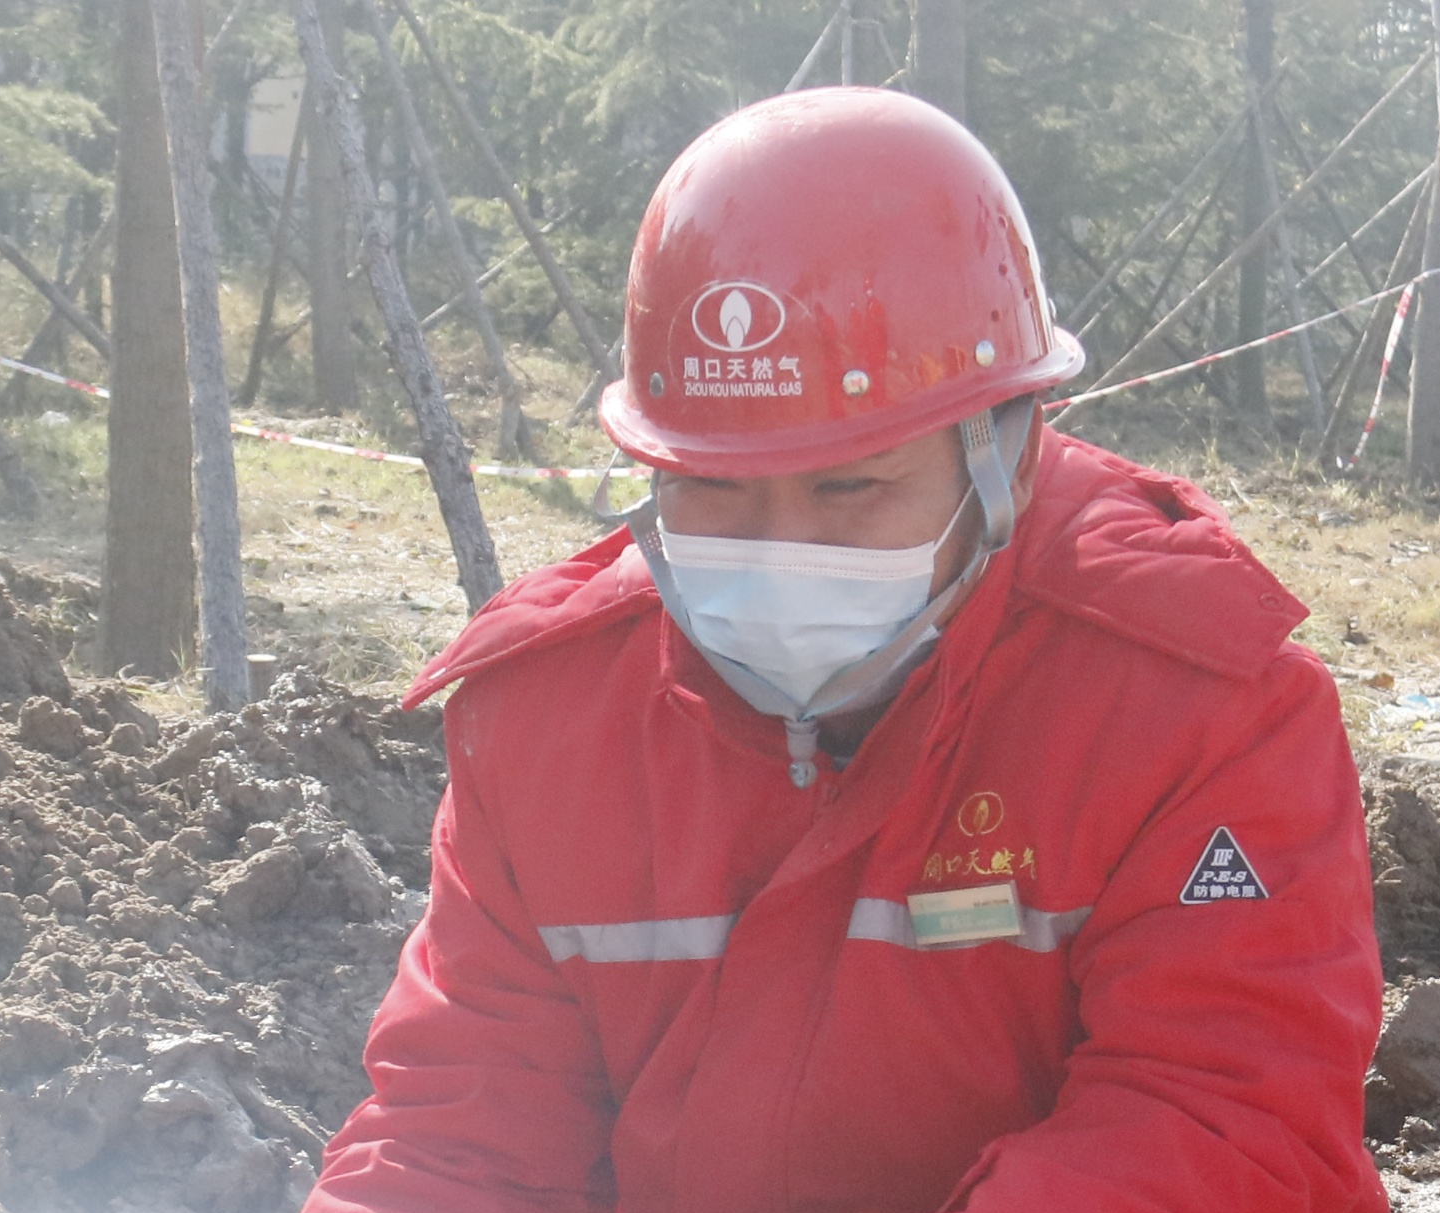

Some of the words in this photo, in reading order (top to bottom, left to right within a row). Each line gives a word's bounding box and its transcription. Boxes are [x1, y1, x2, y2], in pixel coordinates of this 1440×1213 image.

[684, 356, 801, 380] 周口天然气
[730, 382, 778, 397] NATURAL
[779, 381, 802, 396] GAS
[1193, 884, 1256, 898] 防静电服
